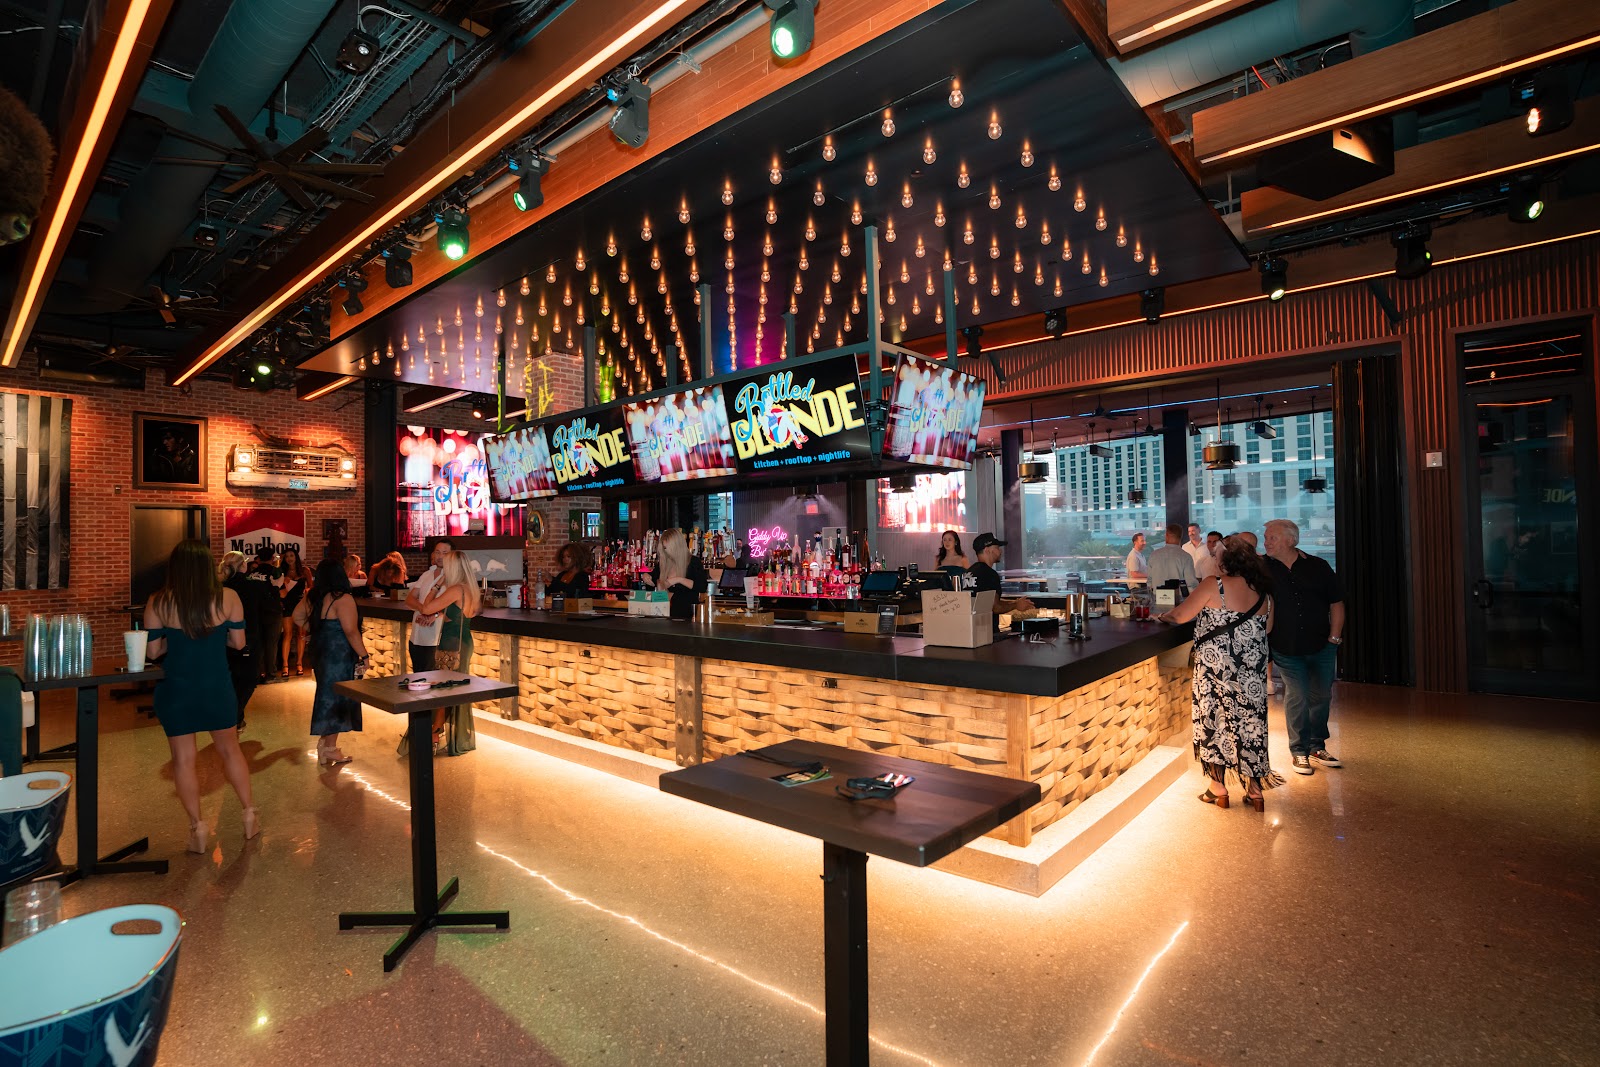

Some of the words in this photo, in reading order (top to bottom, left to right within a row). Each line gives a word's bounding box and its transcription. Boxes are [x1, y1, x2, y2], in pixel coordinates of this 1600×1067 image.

[730, 382, 865, 460] BLONDE
[735, 371, 815, 442] Bottled
[552, 417, 600, 470] Bottled
[753, 459, 779, 469] kitchen
[785, 455, 812, 465] rooftop
[818, 450, 851, 462] nightlife
[231, 537, 300, 555] Marlboro
[749, 528, 771, 546] Giddy
[772, 526, 787, 541] Up
